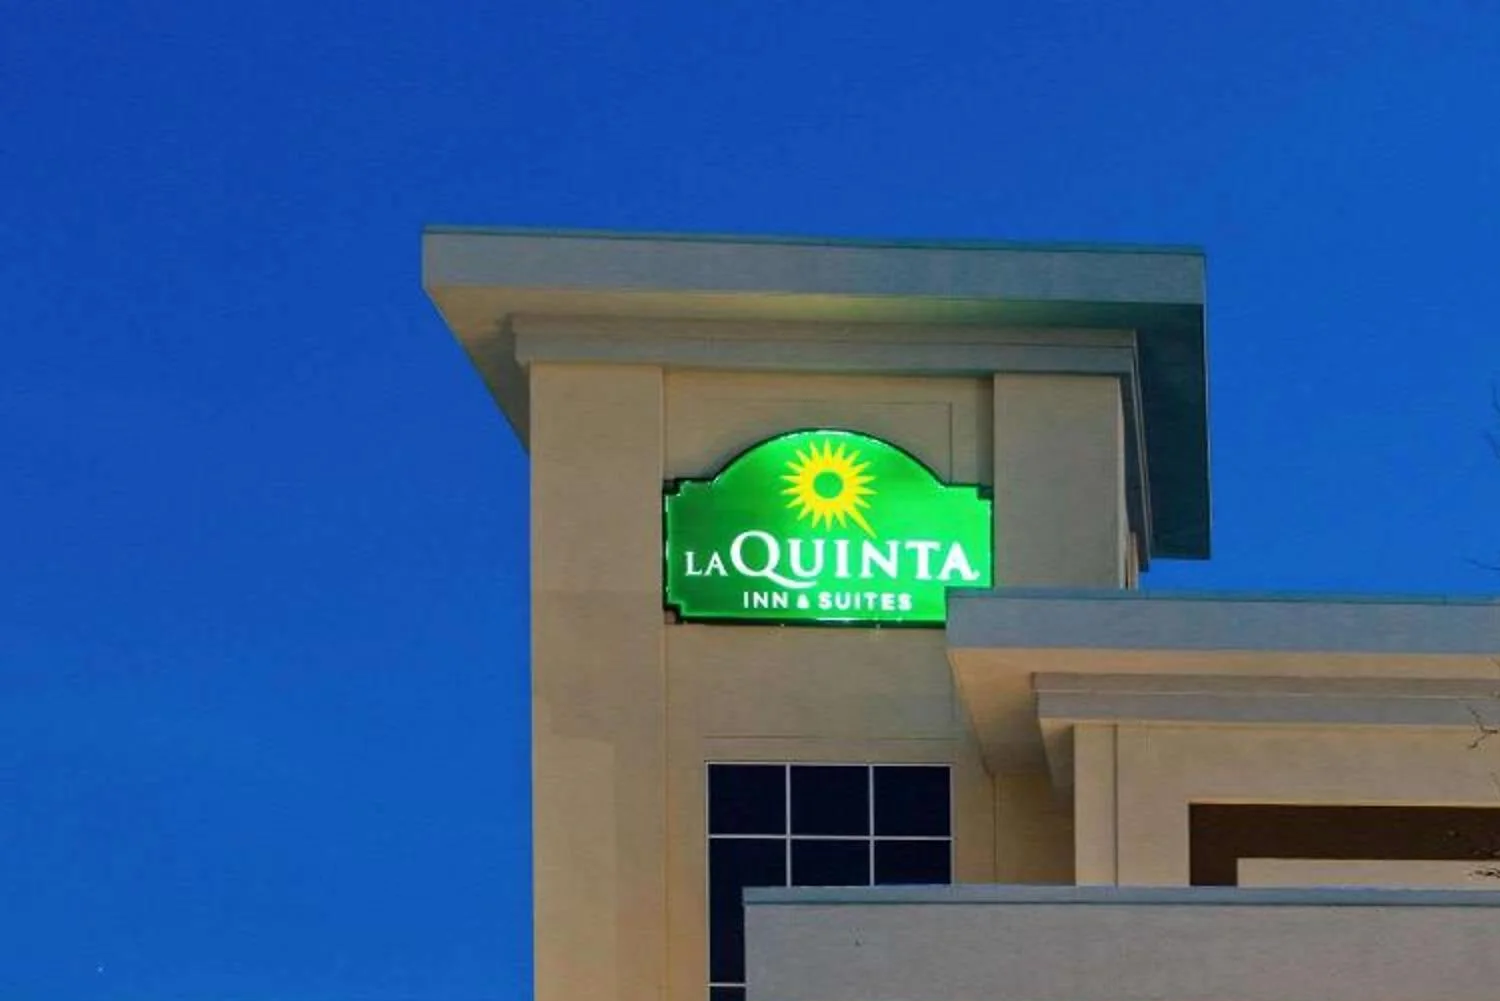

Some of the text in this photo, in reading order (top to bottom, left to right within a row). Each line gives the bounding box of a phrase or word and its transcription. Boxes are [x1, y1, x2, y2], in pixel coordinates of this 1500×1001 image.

[730, 530, 981, 589] QUINTA
[743, 591, 789, 609] INN
[818, 592, 913, 611] SUITES
